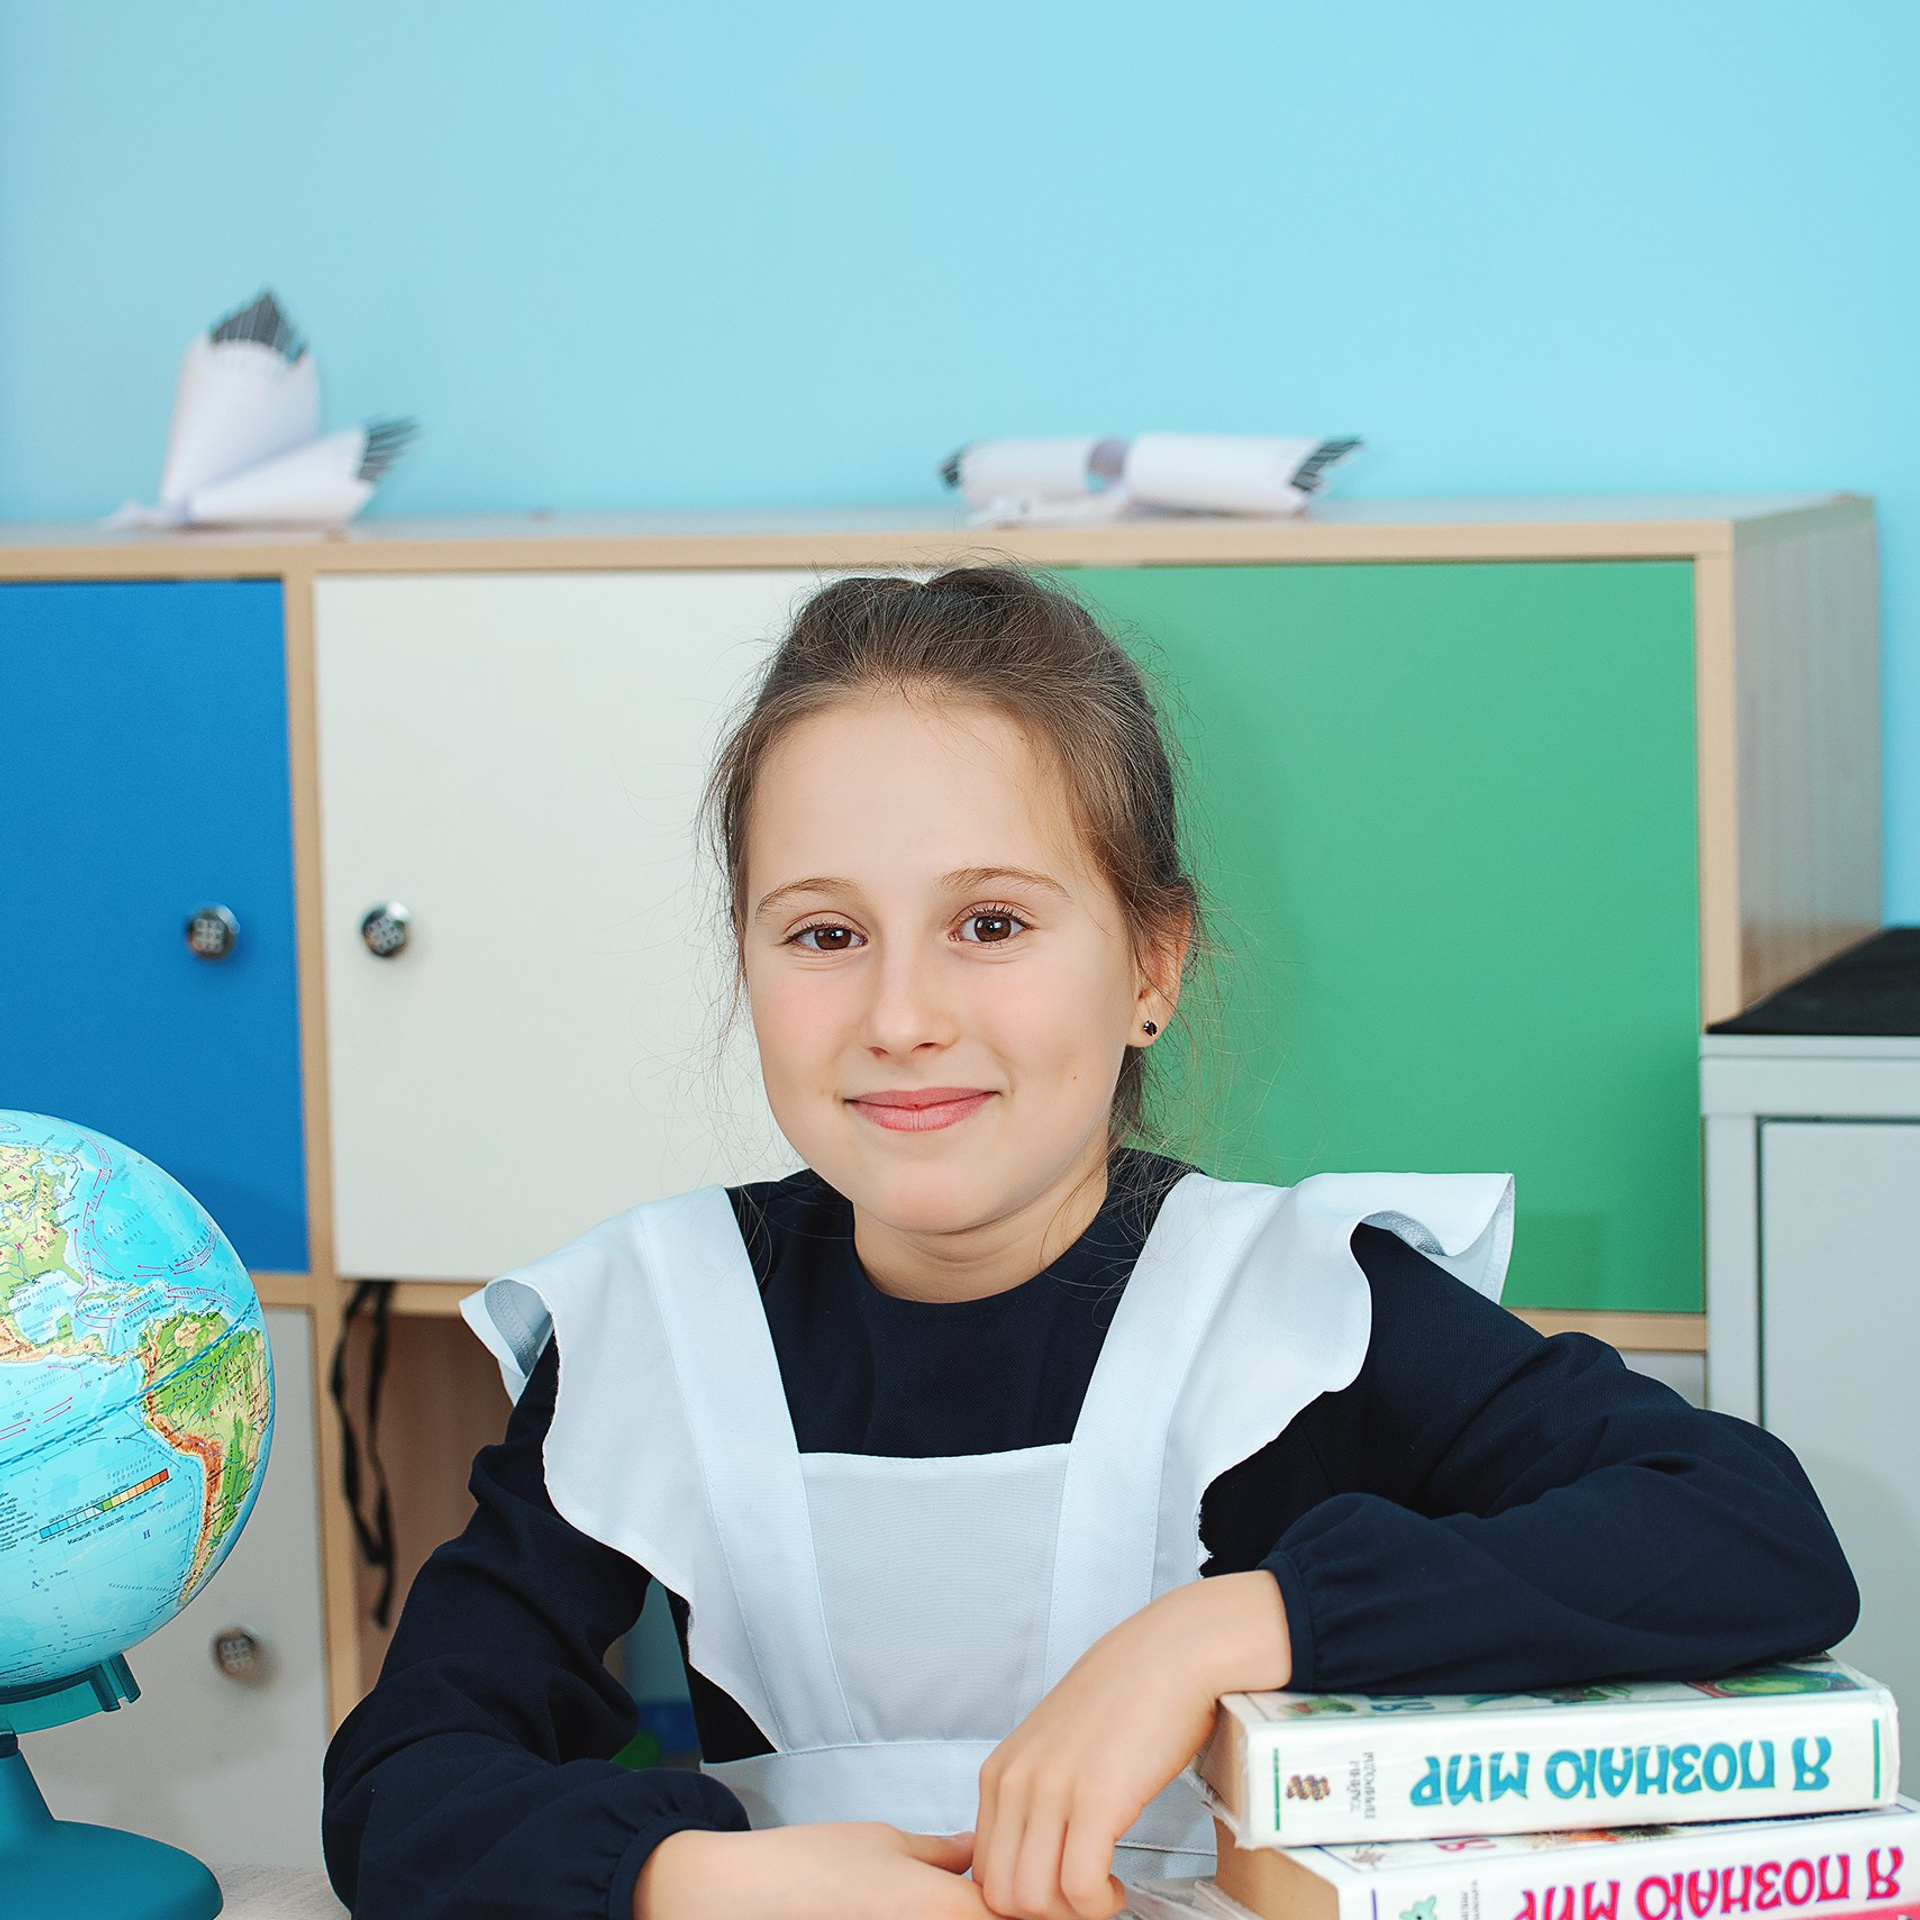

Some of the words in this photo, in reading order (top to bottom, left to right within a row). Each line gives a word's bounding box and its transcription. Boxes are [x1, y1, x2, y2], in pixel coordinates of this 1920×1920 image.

[1362, 1752, 1377, 1820] ПРИРОДЫ
[1410, 1752, 1530, 1808] МИР
[1545, 1740, 1776, 1800] ПОЗНАЮ
[1791, 1736, 1832, 1791] Я
[1635, 1853, 1851, 1920] ПОЗНАЮ
[1866, 1846, 1904, 1901] Я
